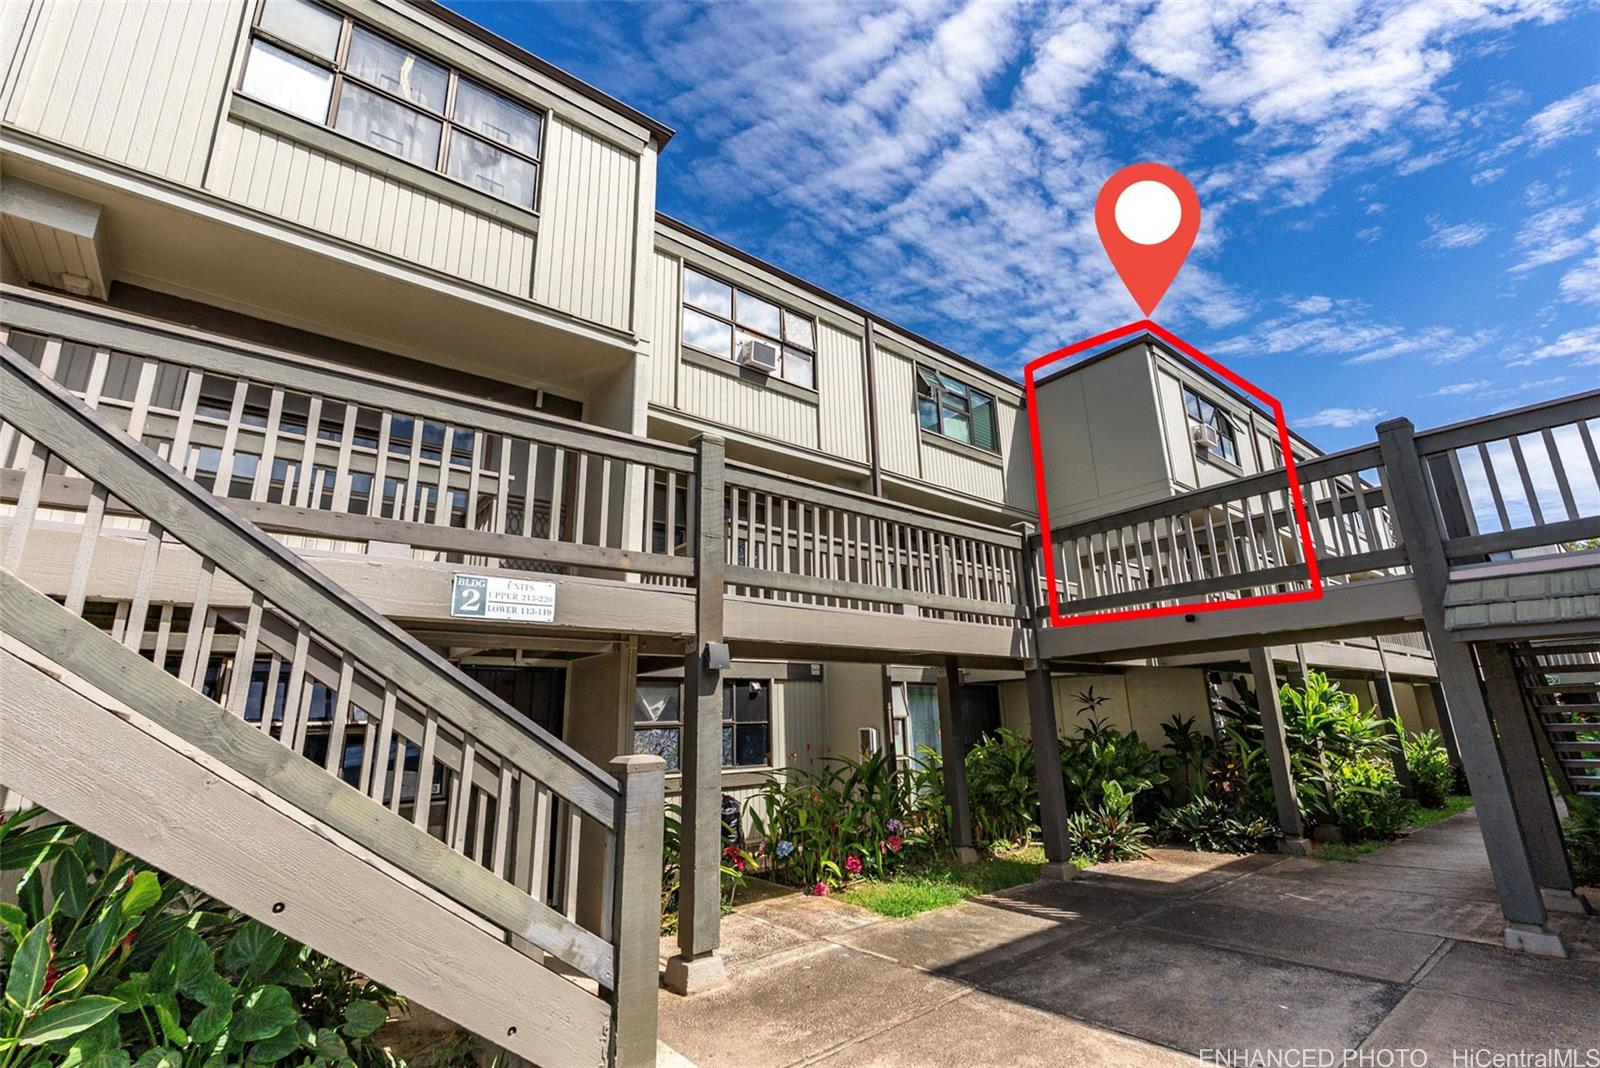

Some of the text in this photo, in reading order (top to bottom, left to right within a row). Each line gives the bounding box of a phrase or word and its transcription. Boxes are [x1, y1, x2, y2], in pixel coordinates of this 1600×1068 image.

[458, 577, 486, 588] BLDG
[507, 582, 535, 591] UNITS
[460, 589, 481, 611] 2
[488, 591, 518, 601] UPPER
[487, 605, 552, 616] LOWER 113-119
